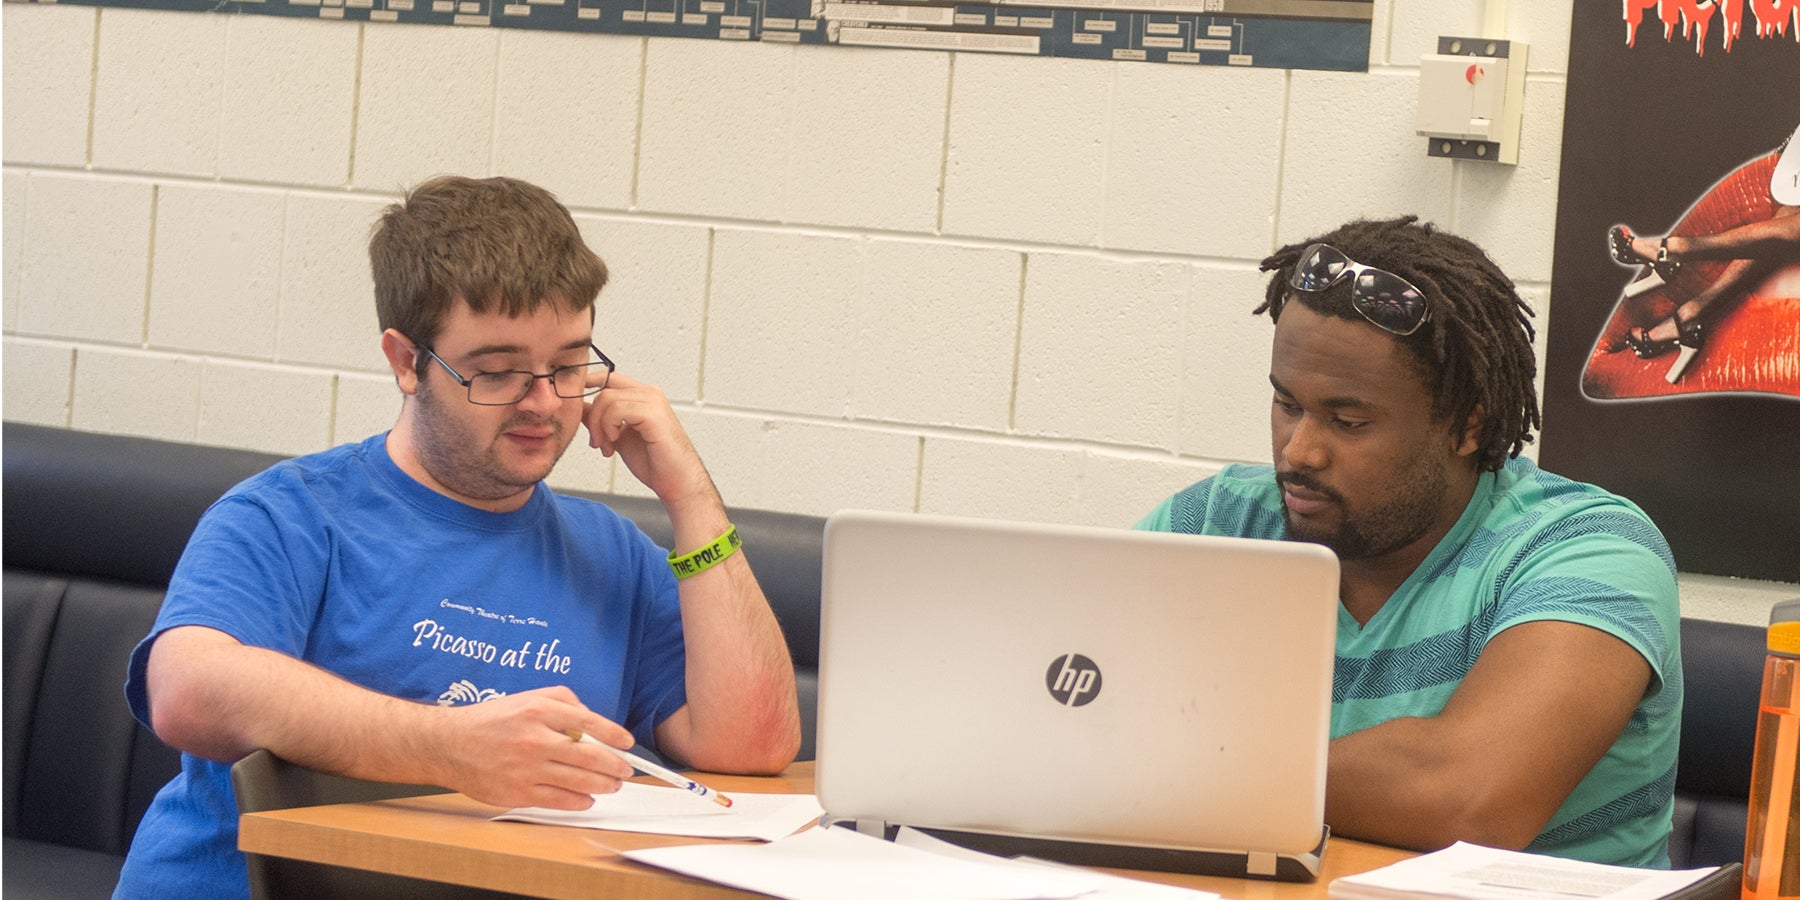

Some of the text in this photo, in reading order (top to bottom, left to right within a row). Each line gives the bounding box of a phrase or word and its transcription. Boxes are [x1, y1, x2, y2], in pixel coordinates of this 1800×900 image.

[672, 543, 724, 576] THE POLE
[500, 614, 508, 624] of
[412, 618, 571, 675] Picasso at the
[1052, 652, 1098, 707] hp
